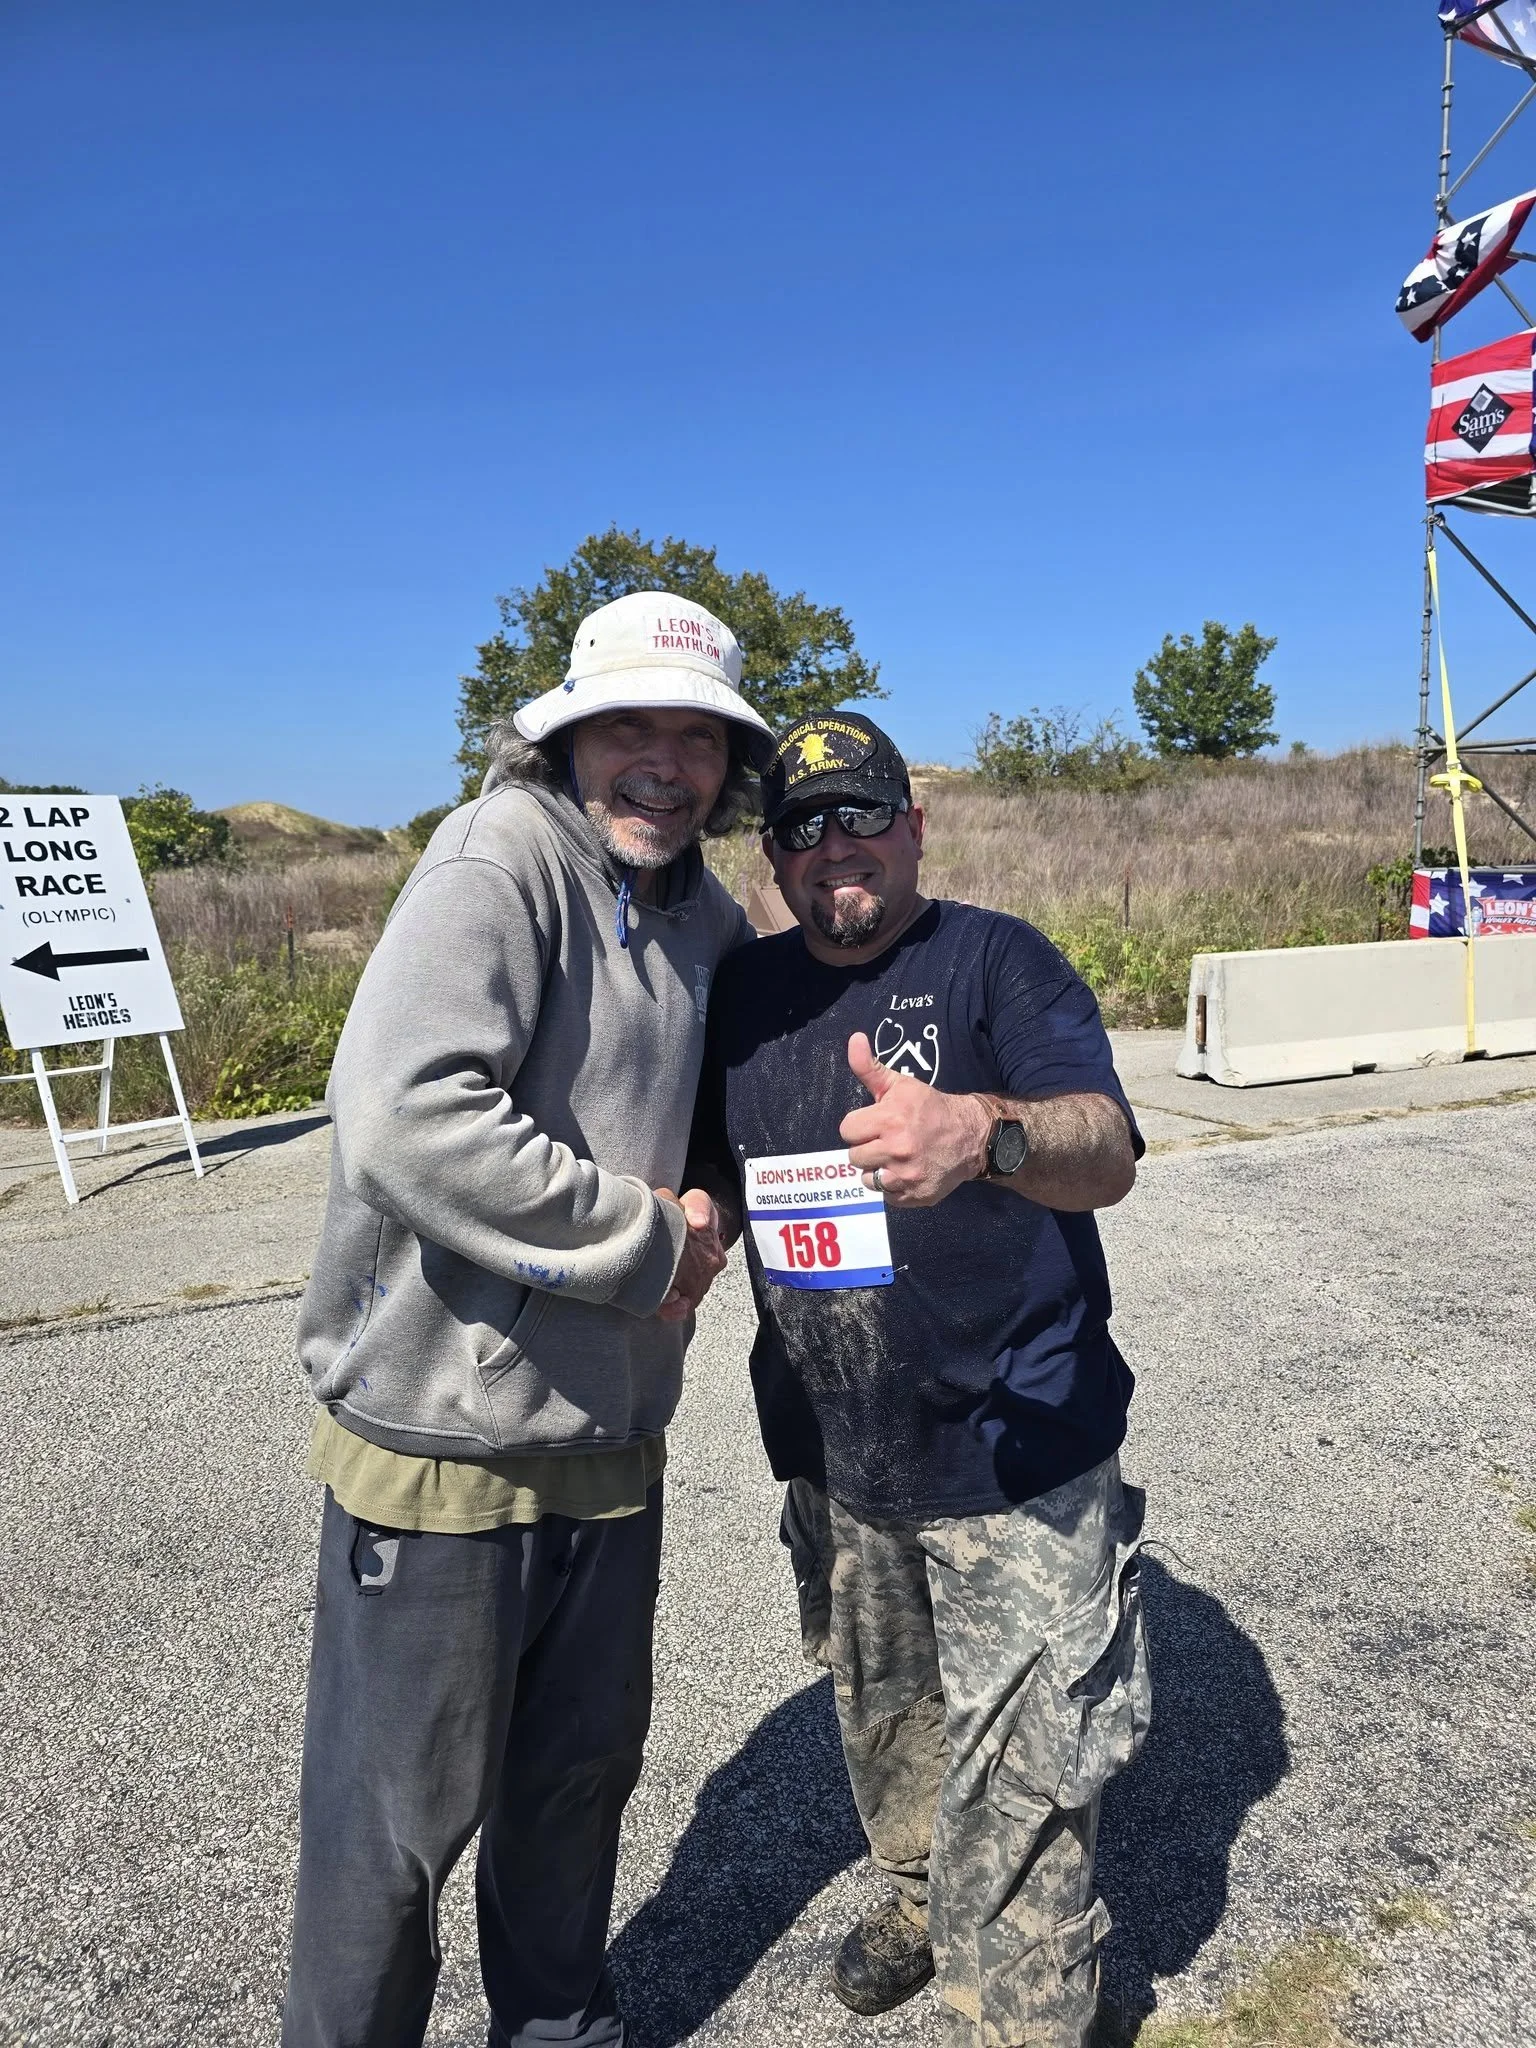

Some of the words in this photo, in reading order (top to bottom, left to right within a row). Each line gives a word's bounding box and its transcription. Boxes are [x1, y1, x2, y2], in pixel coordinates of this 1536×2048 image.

[1459, 408, 1505, 435] Sam's
[1468, 426, 1494, 438] CLUB
[658, 618, 714, 642] LEON'S
[652, 635, 720, 660] TRIATHLON
[817, 720, 872, 745] OPERATIONS
[788, 768, 807, 785] U.S.
[0, 807, 14, 828] 2
[23, 807, 90, 828] LAP
[4, 841, 98, 862] LONG
[15, 874, 106, 897] RACE
[22, 907, 116, 928] (OLYMPIC)
[68, 992, 117, 1012] LEON'S
[889, 994, 934, 1011] Leva's
[62, 1008, 132, 1030] HEROES
[756, 1169, 794, 1185] LEON'S
[796, 1162, 857, 1183] HEROES
[756, 1193, 793, 1205] OBSTACLE
[793, 1190, 833, 1204] COURSE
[835, 1187, 865, 1200] RACE
[778, 1221, 842, 1269] 158
